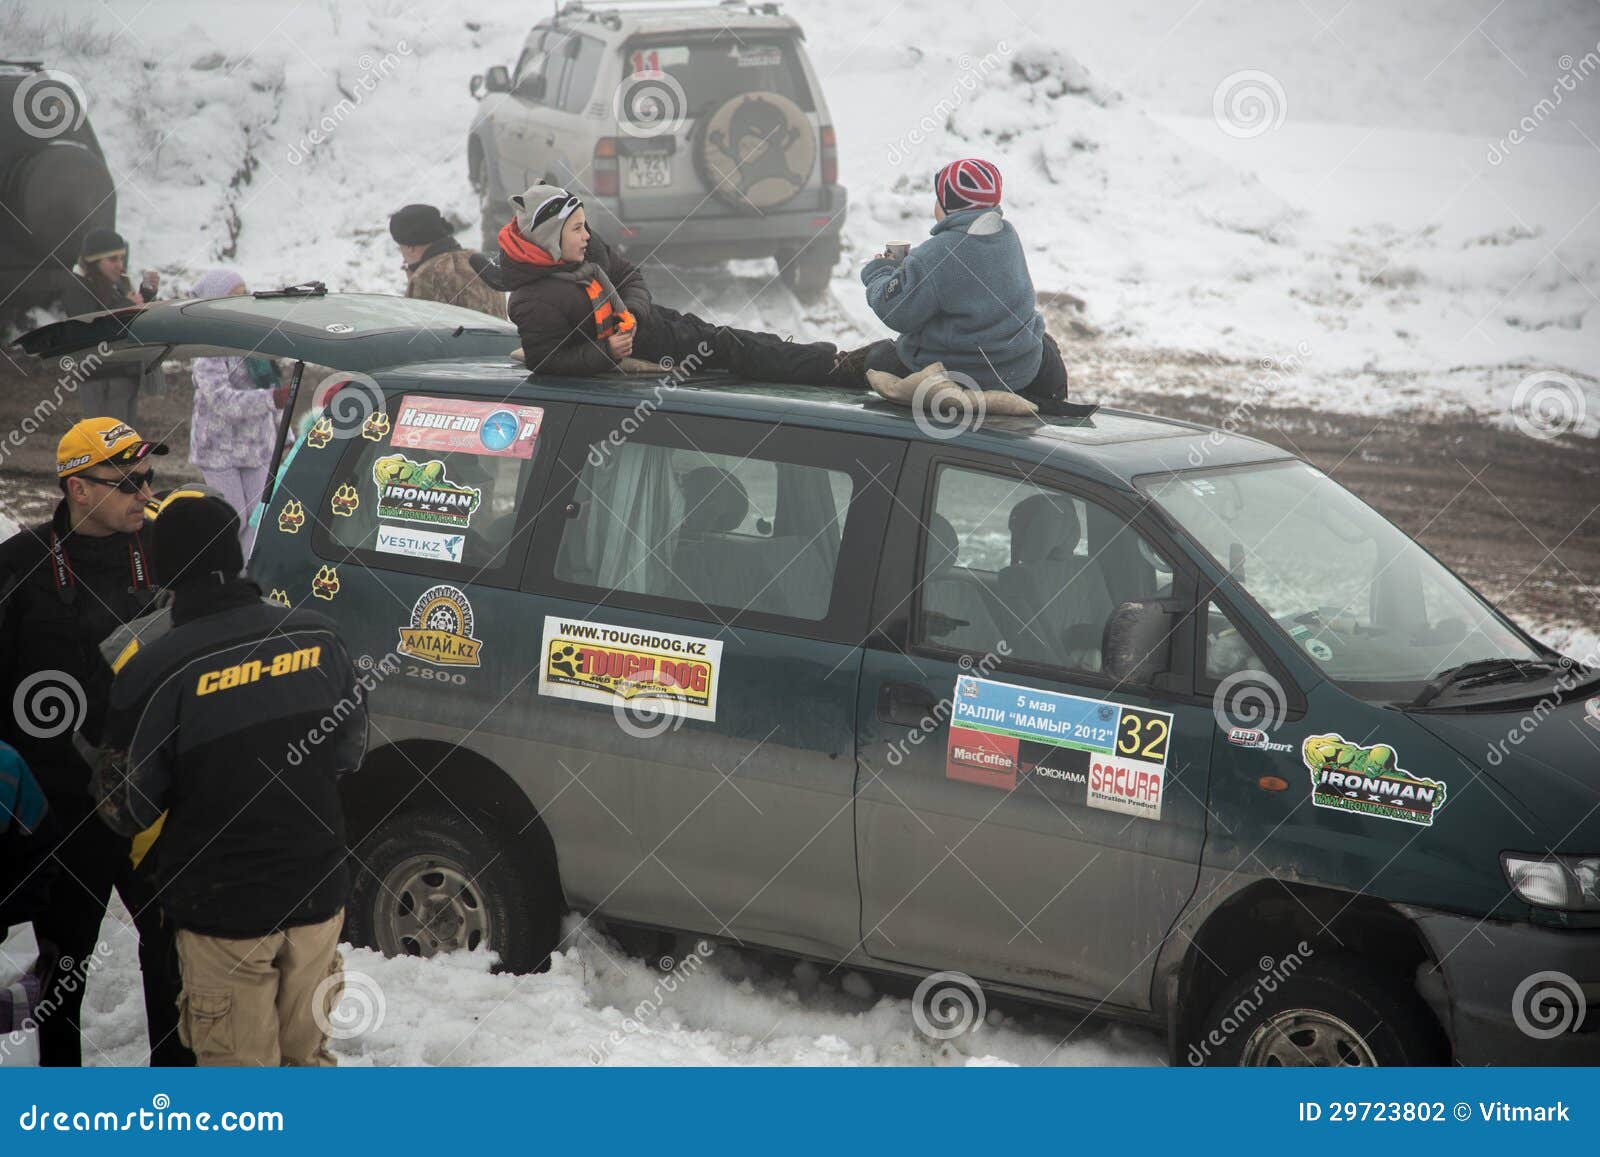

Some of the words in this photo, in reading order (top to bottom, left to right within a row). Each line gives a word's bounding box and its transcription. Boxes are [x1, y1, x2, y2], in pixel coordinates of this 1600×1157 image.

[631, 51, 663, 78] 11
[384, 485, 473, 508] IRONMAN
[379, 533, 441, 552] VESTI.KZ
[133, 551, 144, 581] Canon
[405, 634, 475, 658] АЛТАЙ.KZ
[560, 622, 707, 656] WWW.TOUGHDOG.KZ
[196, 645, 321, 696] can-am
[405, 665, 467, 685] 2800
[579, 648, 656, 684] TOUGH
[659, 659, 708, 692] DOG
[958, 702, 1006, 723] РАЛЛИ
[1016, 695, 1027, 708] 5
[1029, 700, 1057, 713] мая
[1118, 714, 1168, 760] 32
[953, 745, 1013, 767] MacCoffee
[1035, 766, 1087, 785] YOKOHAMA
[1091, 762, 1161, 803] SAKURA
[1321, 770, 1435, 802] IRONMAN
